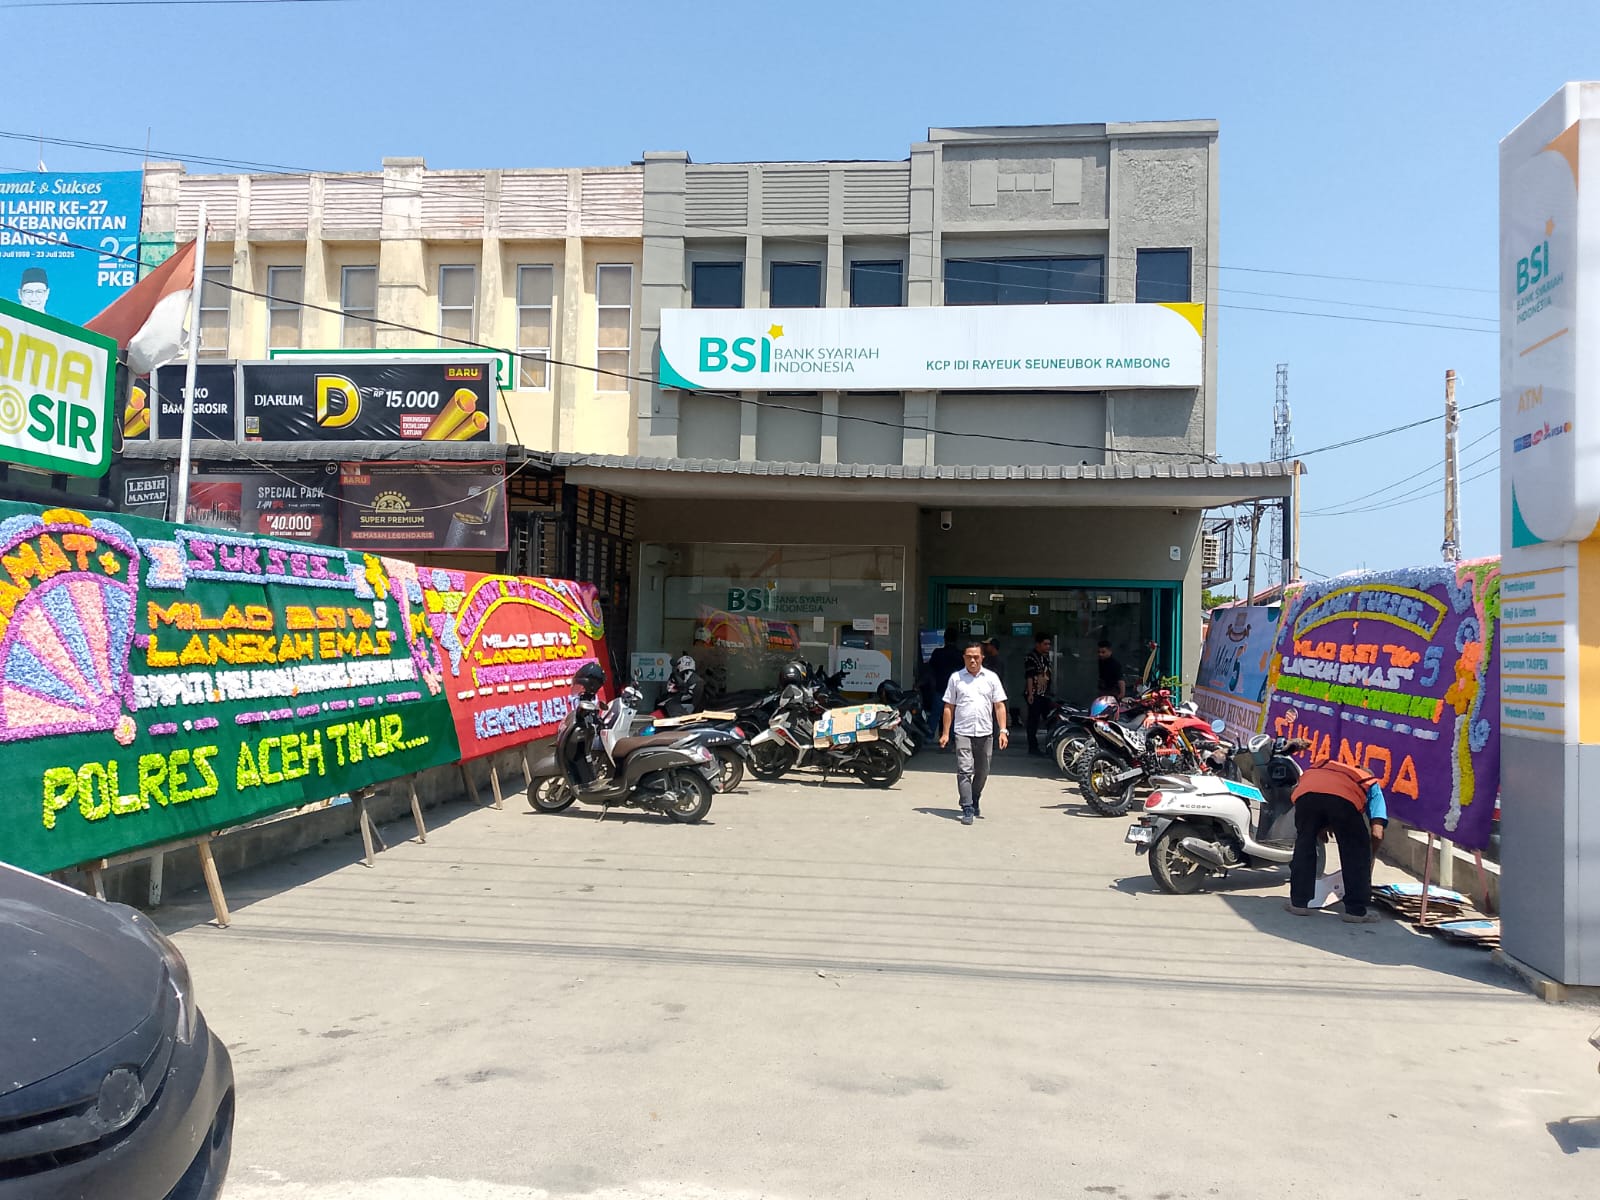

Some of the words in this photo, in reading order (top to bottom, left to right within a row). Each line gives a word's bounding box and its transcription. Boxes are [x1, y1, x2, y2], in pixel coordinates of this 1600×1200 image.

[52, 179, 102, 194] Sukses
[9, 200, 55, 215] LAHIR
[60, 200, 108, 215] KE-27
[9, 216, 127, 230] KEBANGKITAN
[0, 232, 69, 245] BANGSA
[1516, 241, 1549, 295] BSI
[97, 271, 135, 287] PKB
[699, 336, 771, 373] BSI
[774, 348, 814, 359] BANK
[818, 347, 879, 359] SYARIAH
[774, 361, 855, 373] INDONESIA
[926, 360, 950, 371] KCP
[954, 360, 969, 370] IDI
[972, 359, 1022, 370] RAYEUK
[1025, 358, 1102, 369] SEUNEUBOK
[1106, 358, 1171, 369] RAMBONG
[448, 368, 478, 377] BARU
[180, 388, 209, 399] TKO
[254, 394, 303, 407] DJARUM
[385, 390, 439, 409] 15.000
[1517, 383, 1543, 415] ATM
[162, 403, 185, 414] BAM
[192, 403, 228, 414] GROSIR
[128, 479, 166, 492] LEBIH
[257, 486, 297, 499] SPECIAL
[300, 486, 324, 498] PACK
[128, 491, 166, 502] MANTAP
[728, 588, 770, 611] BSI
[42, 745, 219, 829] POLRES
[236, 729, 326, 790] ACEH
